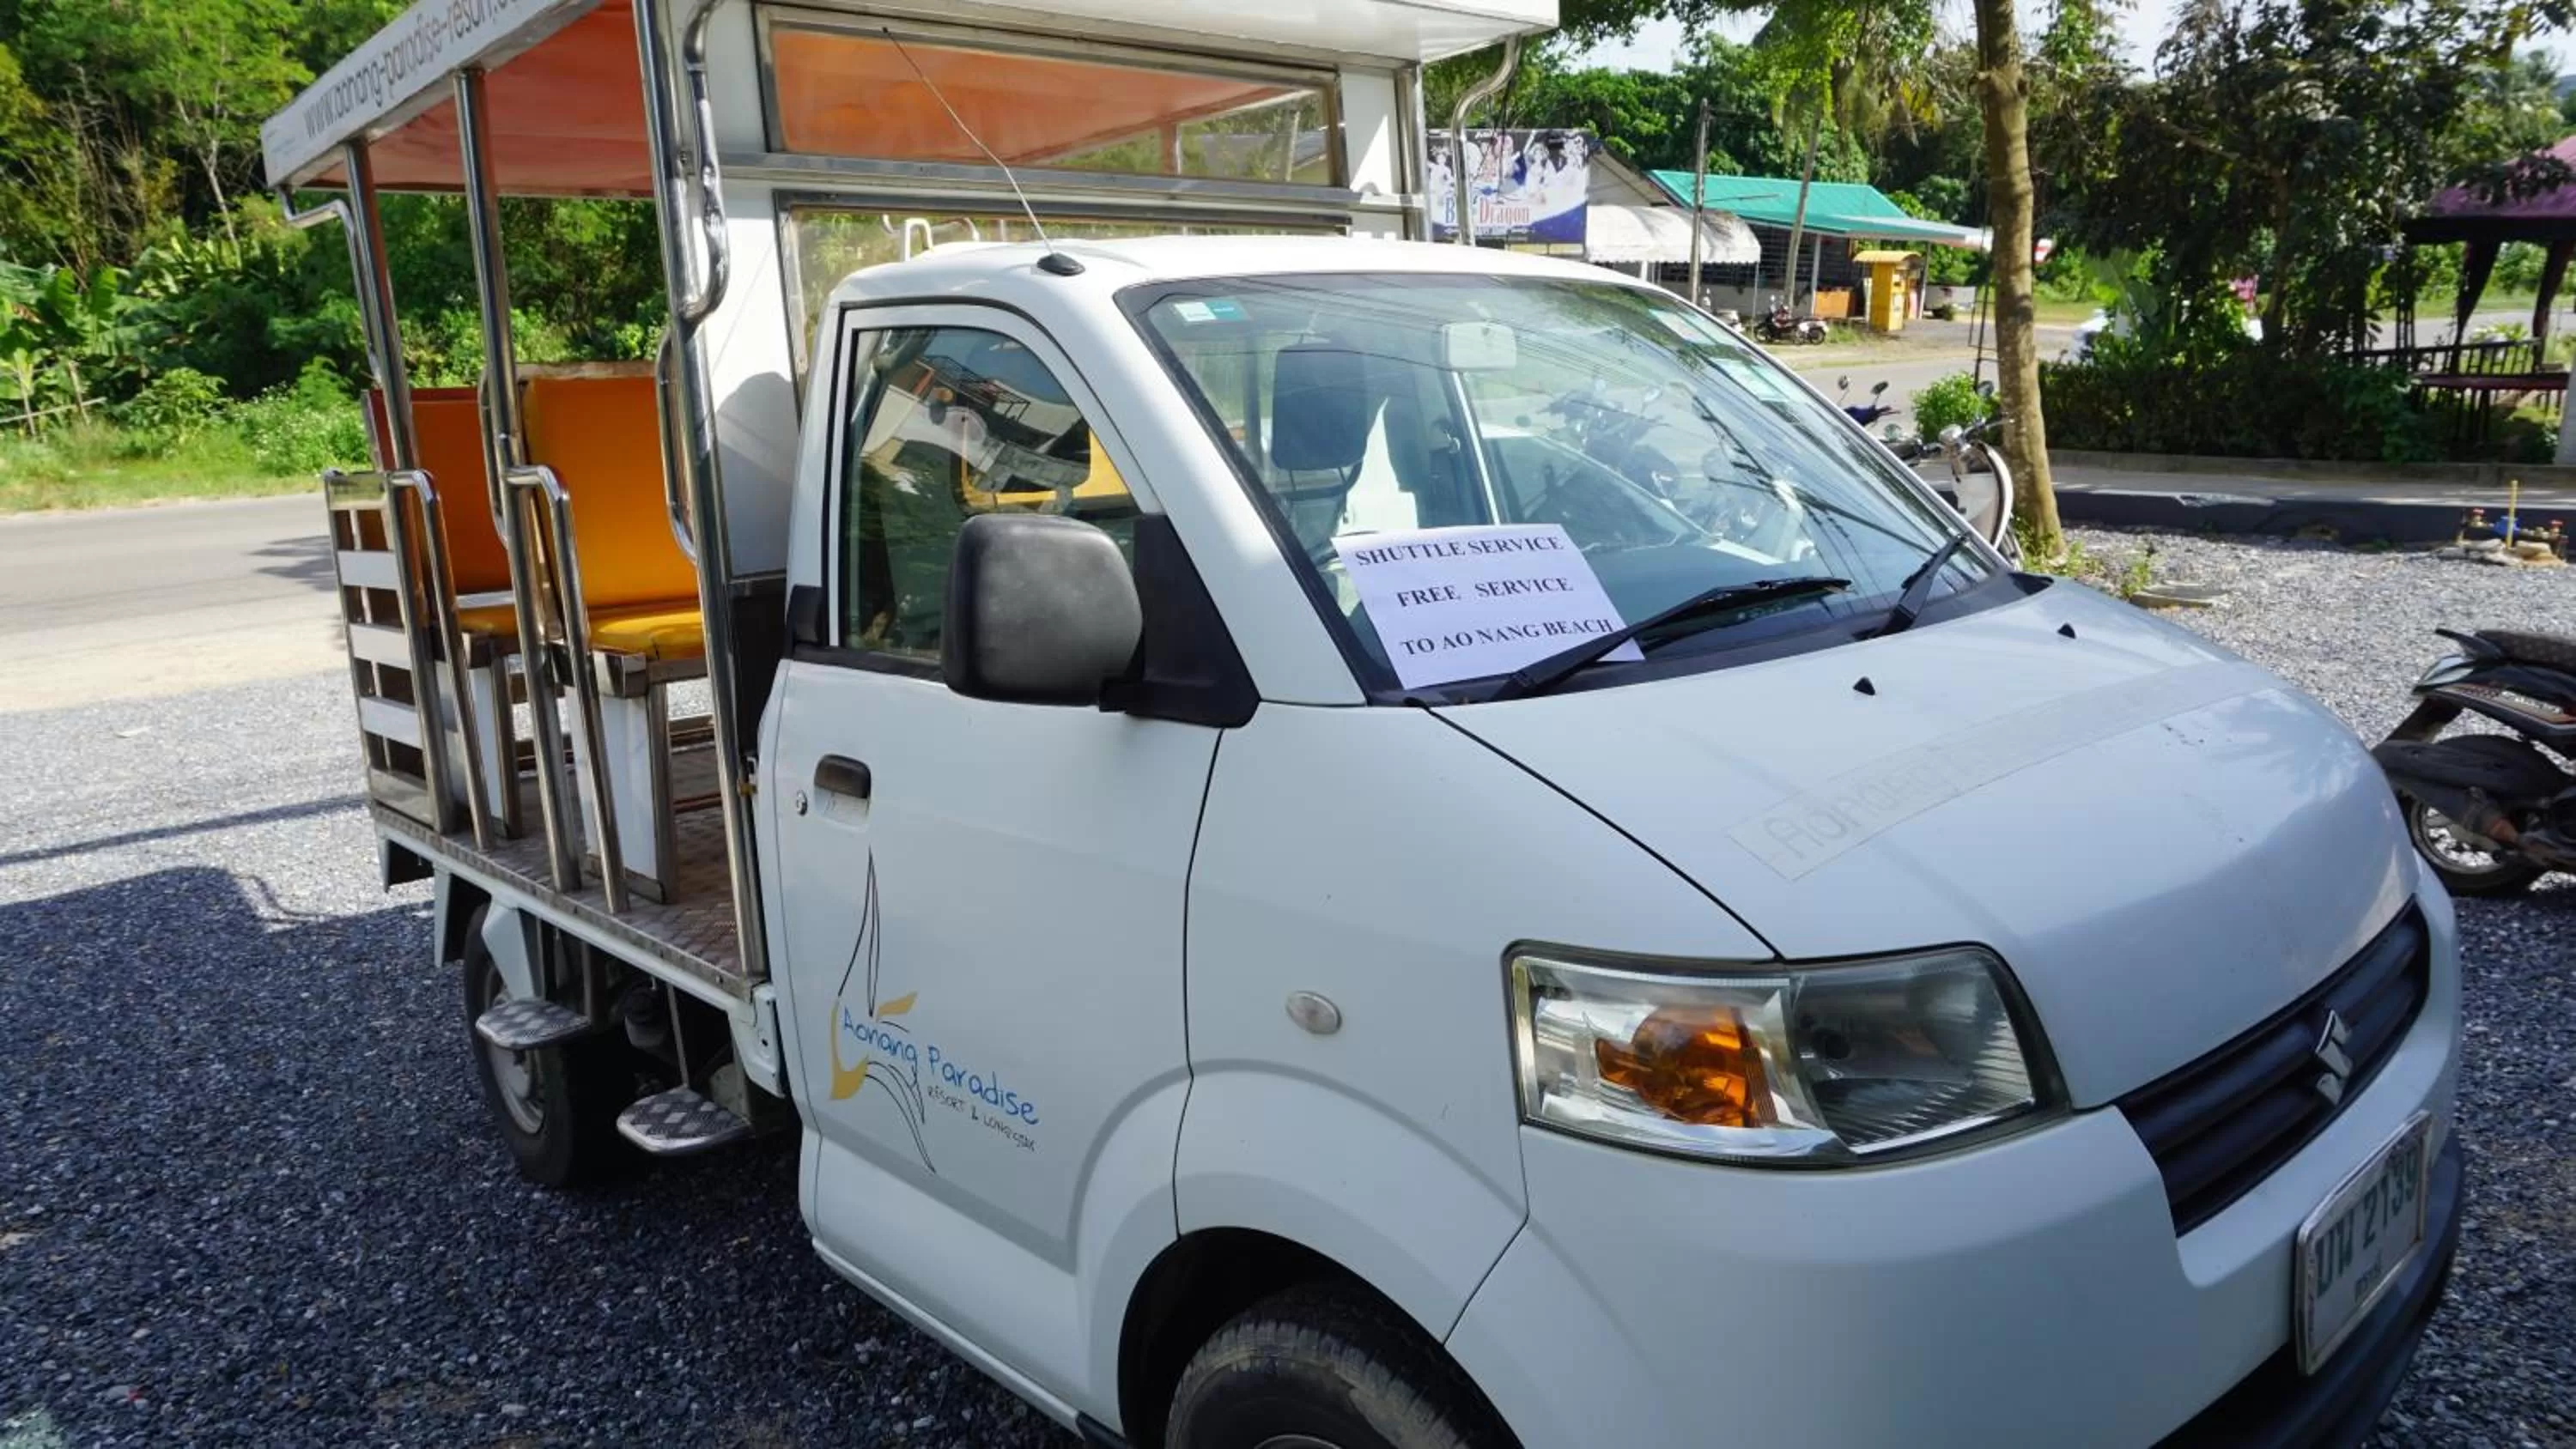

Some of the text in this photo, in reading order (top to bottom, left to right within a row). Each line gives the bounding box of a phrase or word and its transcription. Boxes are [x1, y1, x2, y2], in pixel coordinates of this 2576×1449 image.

[1356, 536, 1564, 567] SHUTTLE SERVICE
[1397, 577, 1574, 607] FREE SERVICE
[1400, 618, 1614, 656] TO AO NANG BEACH
[842, 1006, 1040, 1127] Aonang Paradise
